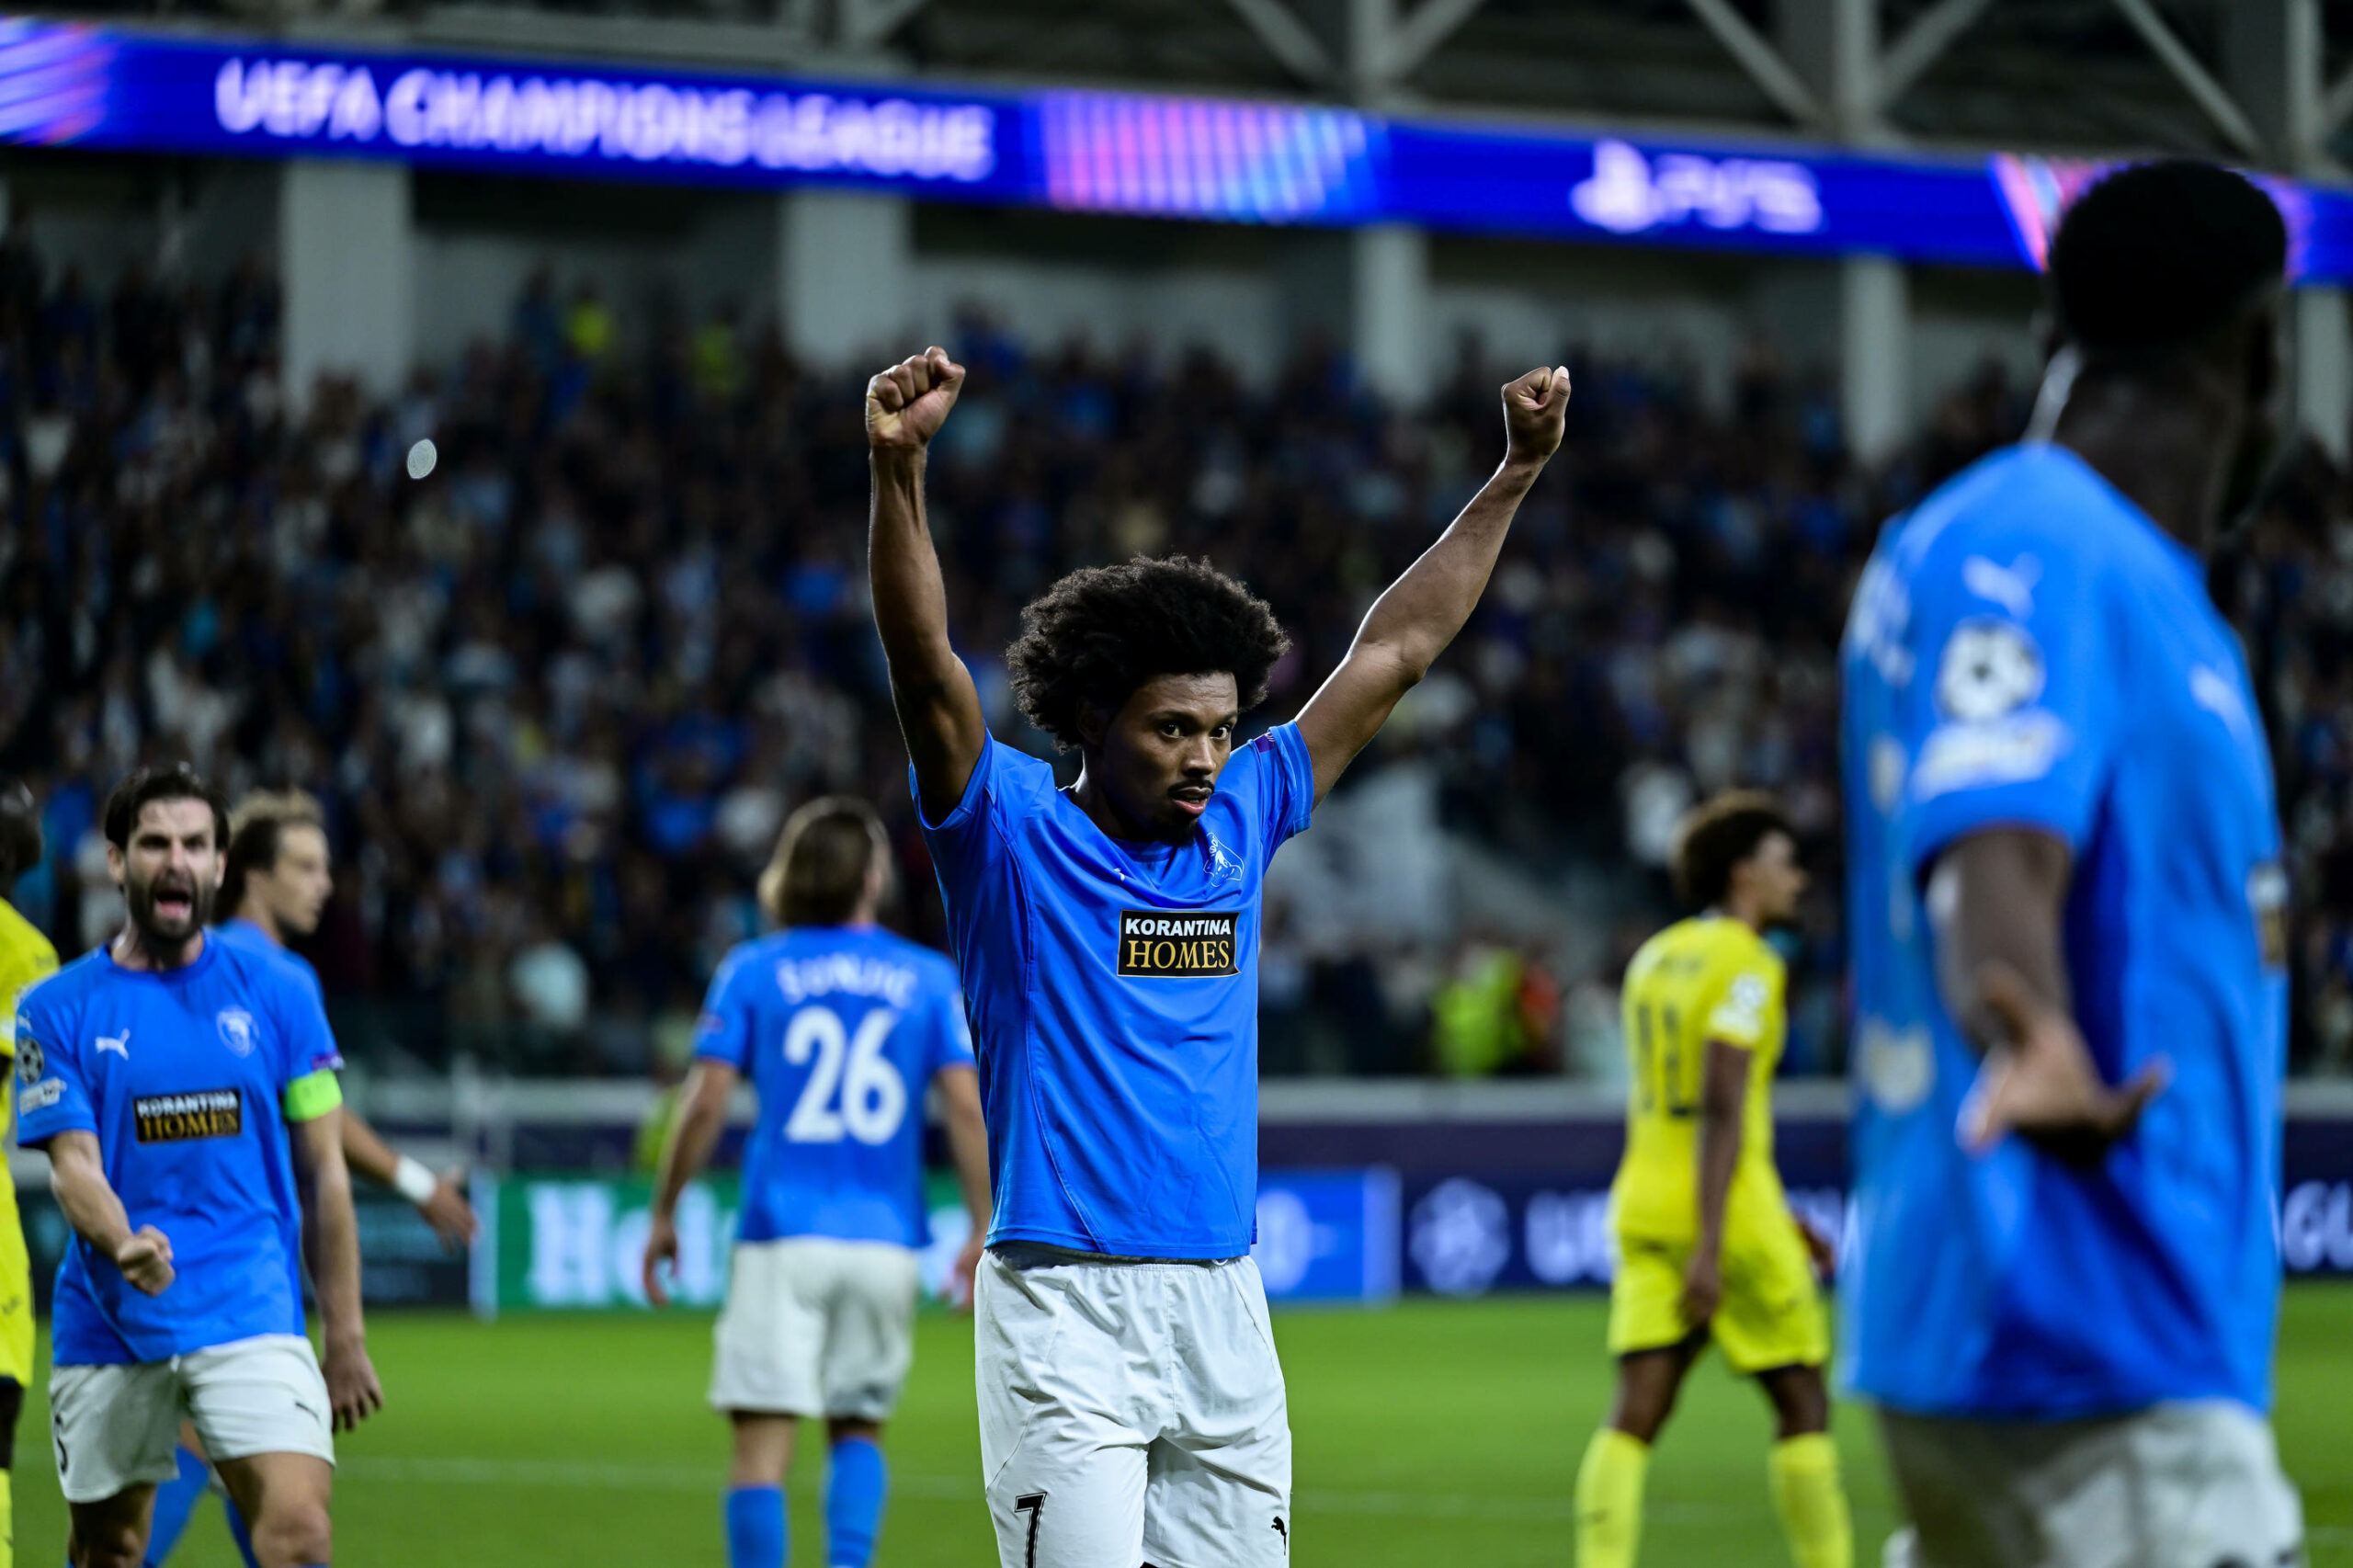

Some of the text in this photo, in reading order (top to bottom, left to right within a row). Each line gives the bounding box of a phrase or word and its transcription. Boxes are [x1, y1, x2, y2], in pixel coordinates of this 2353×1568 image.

[216, 58, 995, 182] UEFA CHAMPIONS LEAGUE
[1125, 918, 1232, 936] KORANTINA
[1126, 939, 1230, 969] HOMES
[784, 1005, 908, 1146] 26
[137, 1091, 238, 1117] KORANTINA
[143, 1111, 238, 1139] HOMES
[1015, 1492, 1047, 1568] 7
